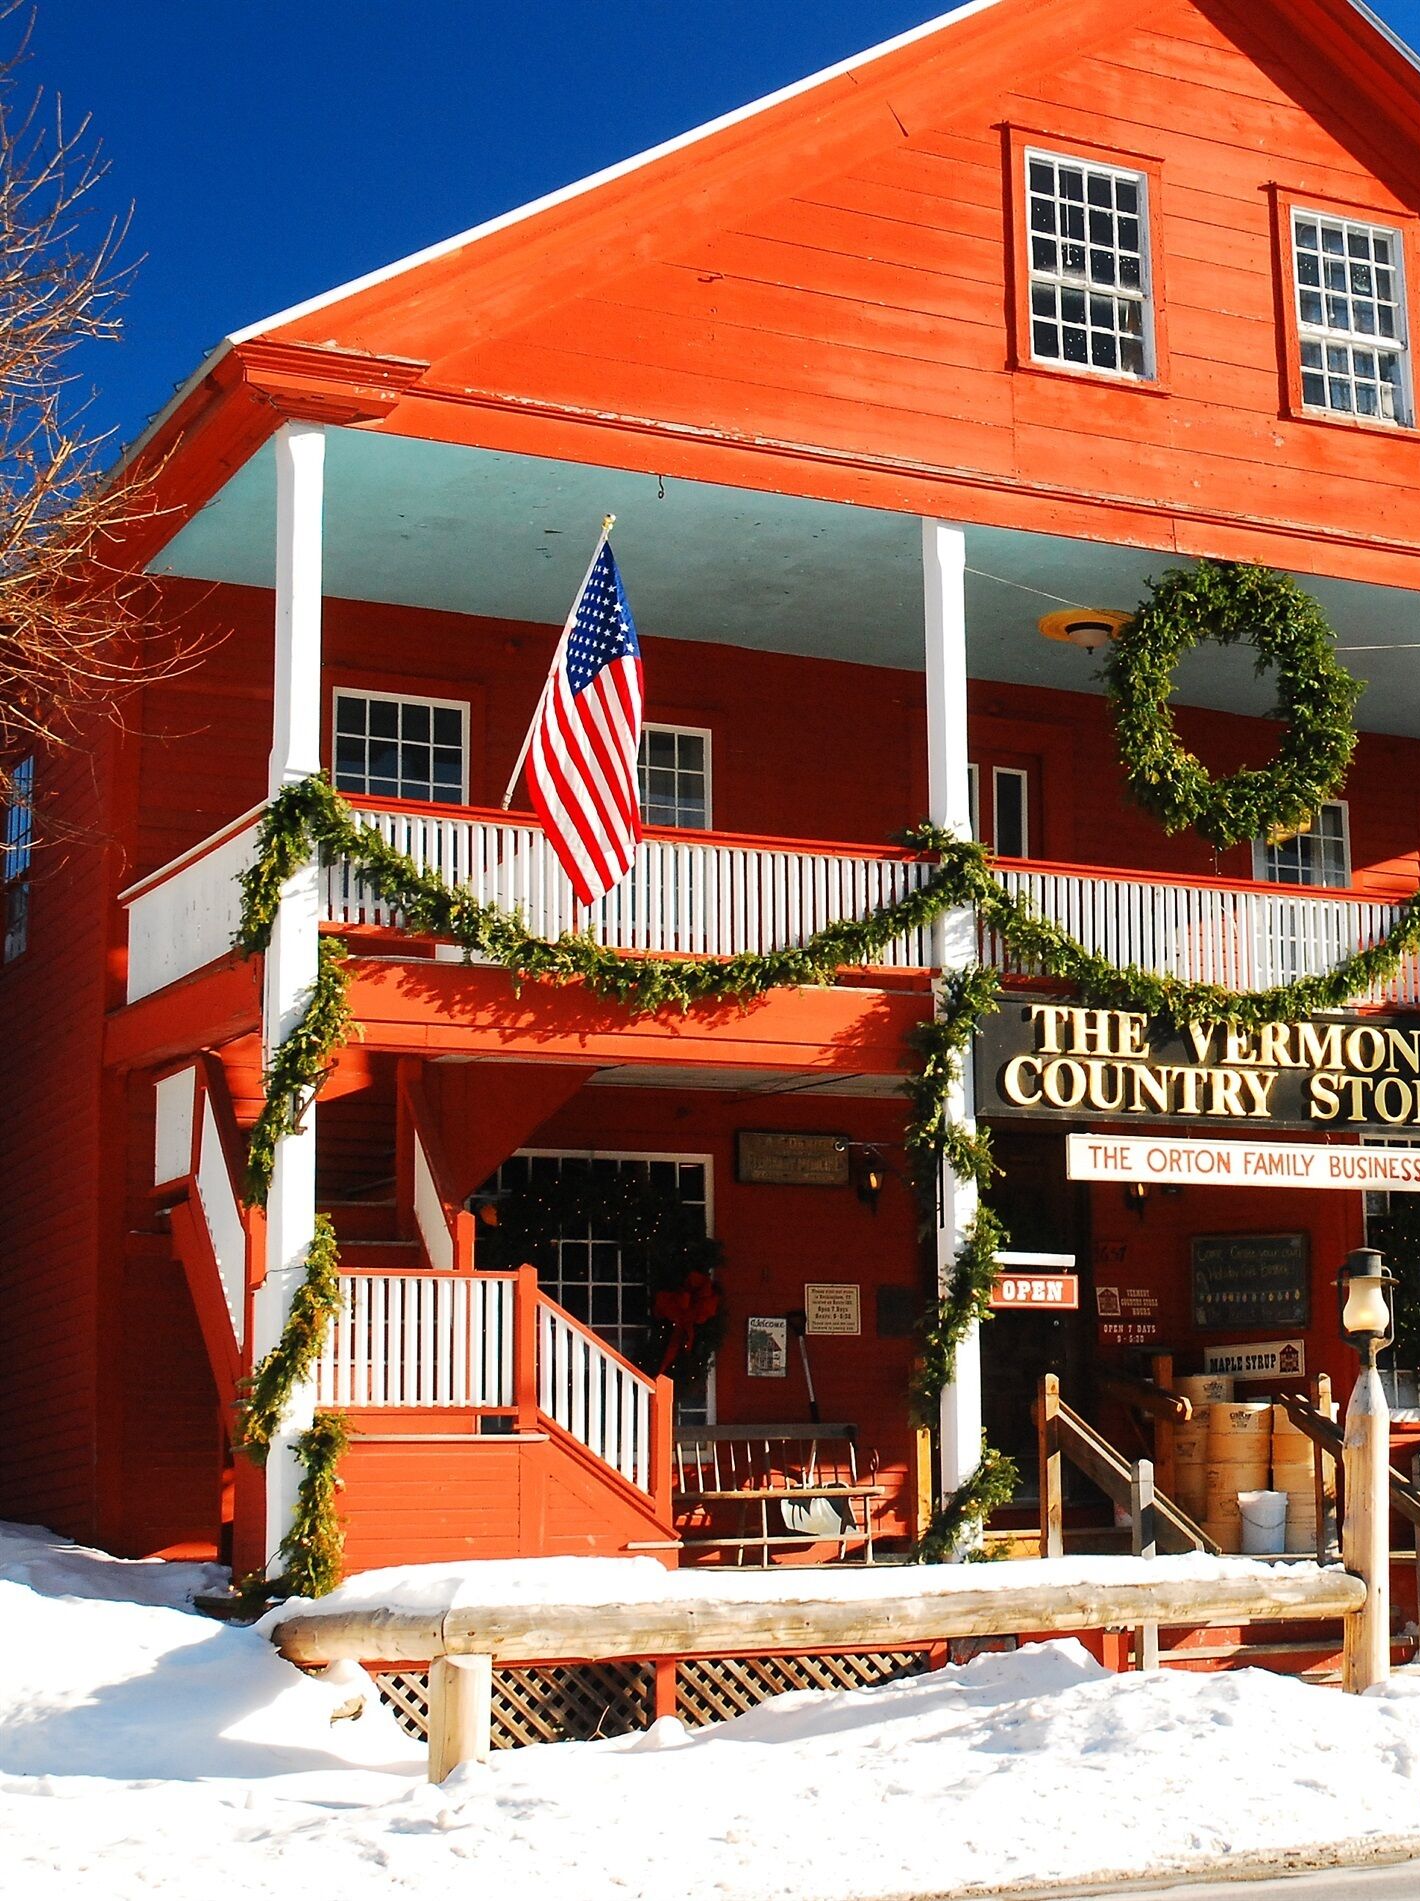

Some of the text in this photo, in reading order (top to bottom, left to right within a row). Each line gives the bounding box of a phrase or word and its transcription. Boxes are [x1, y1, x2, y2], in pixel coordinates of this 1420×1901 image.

[1031, 1004, 1149, 1058] THE
[1004, 1055, 1279, 1117] COUNTRY
[1088, 1145, 1132, 1170] THE
[1147, 1148, 1231, 1174] ORTON
[1243, 1152, 1315, 1177] FAMILY
[1002, 1280, 1063, 1301] OPEN
[751, 1319, 785, 1328] Welcome
[1103, 1324, 1156, 1333] OPEN 7 DAYS
[1209, 1353, 1276, 1373] MAPLE SYRUP
